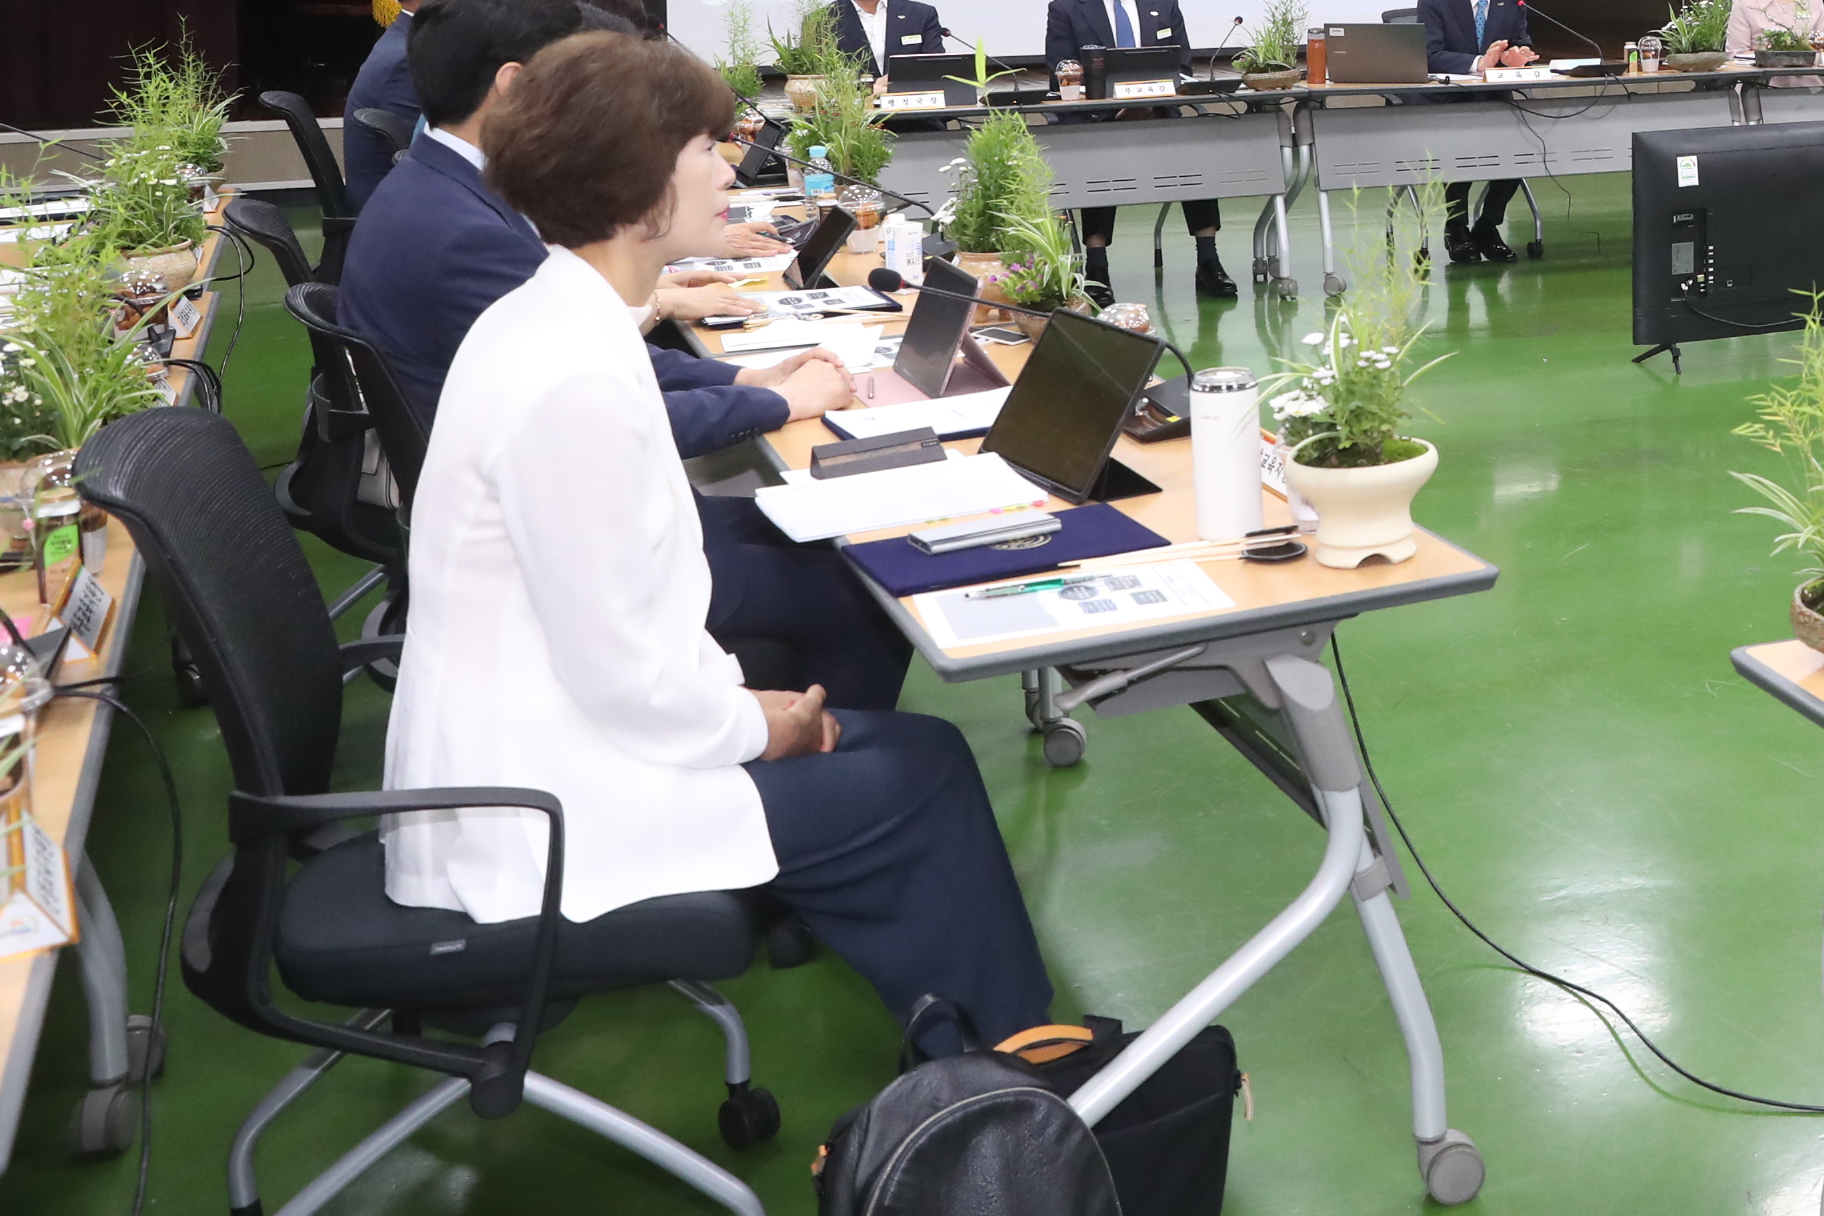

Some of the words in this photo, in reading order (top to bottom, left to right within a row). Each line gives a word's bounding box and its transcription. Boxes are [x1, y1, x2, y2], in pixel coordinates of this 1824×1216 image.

[1497, 70, 1541, 79] 교육감
[1125, 85, 1166, 94] 부교육감
[888, 96, 938, 107] 행정국장
